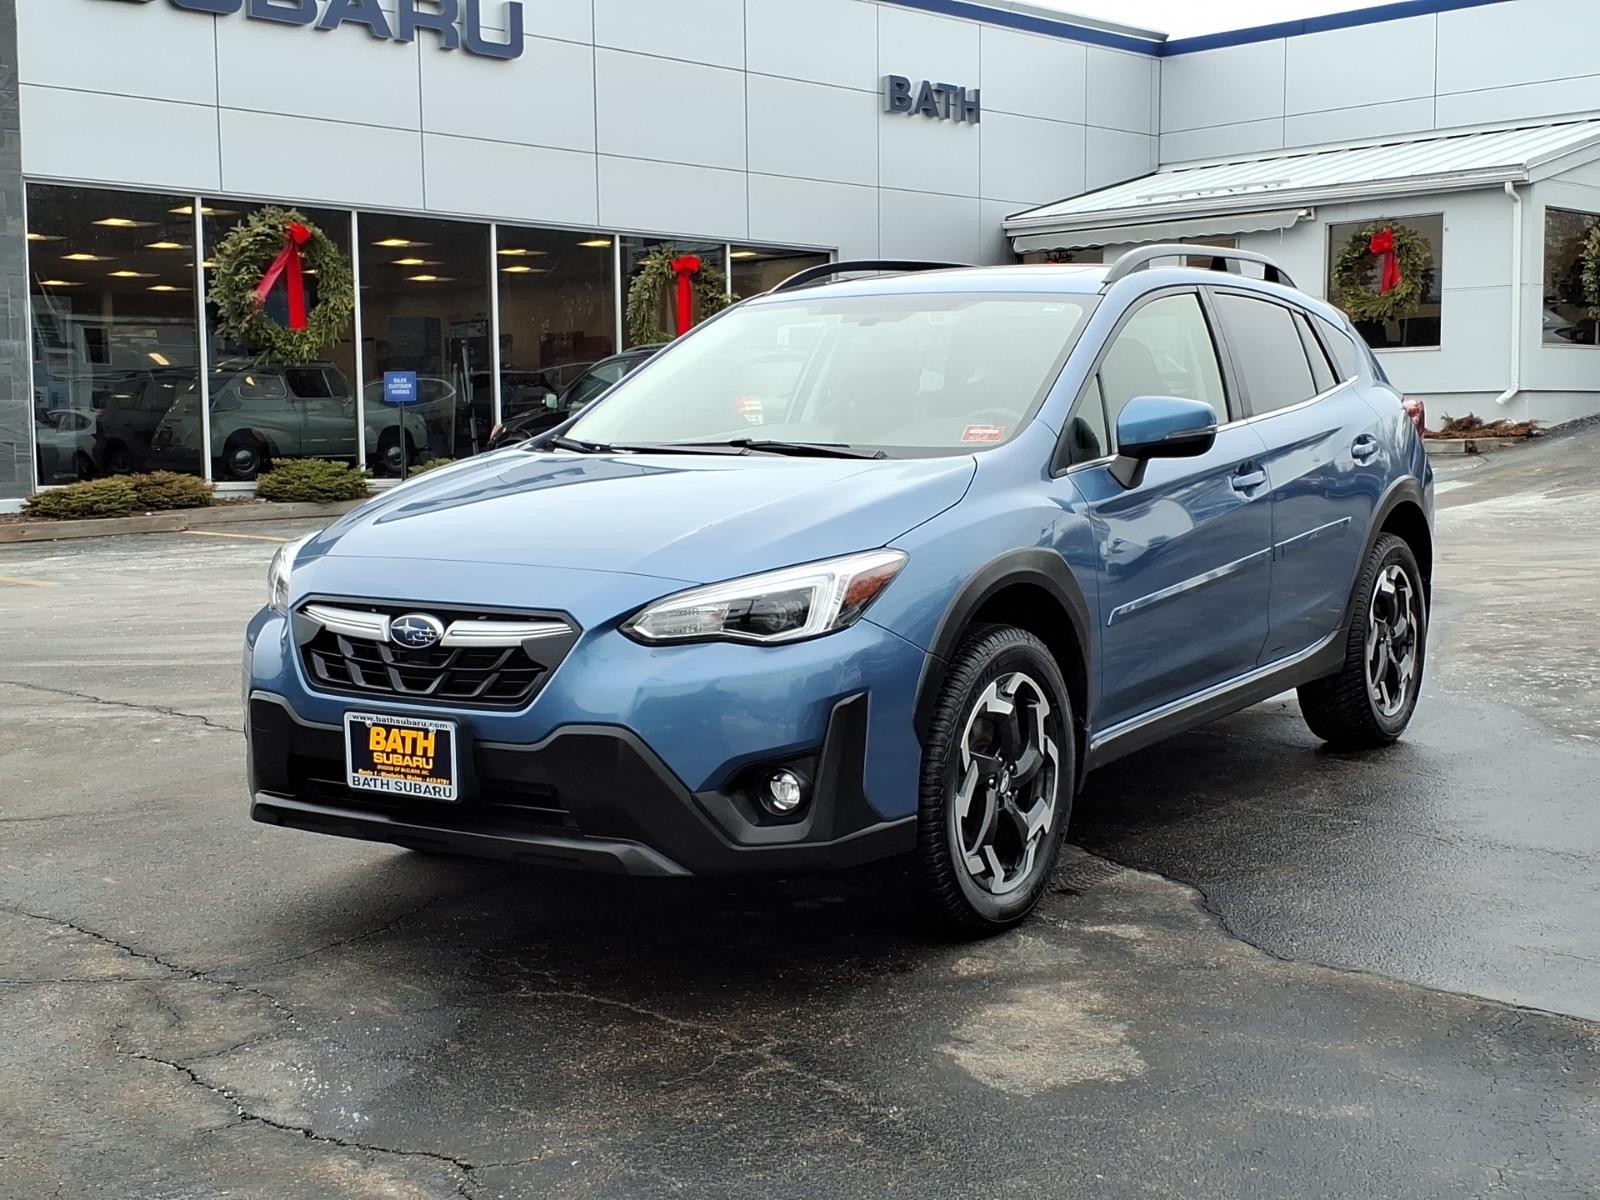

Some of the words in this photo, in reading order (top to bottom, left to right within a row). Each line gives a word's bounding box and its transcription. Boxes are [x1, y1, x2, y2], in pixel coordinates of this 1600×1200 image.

[82, 0, 523, 60] ARU
[882, 74, 980, 124] BATH
[352, 714, 448, 729] www.bathsubaru.com
[369, 726, 436, 757] BATH
[373, 751, 433, 769] SUBARU
[352, 775, 390, 790] BATH
[394, 780, 452, 798] SUBARU
